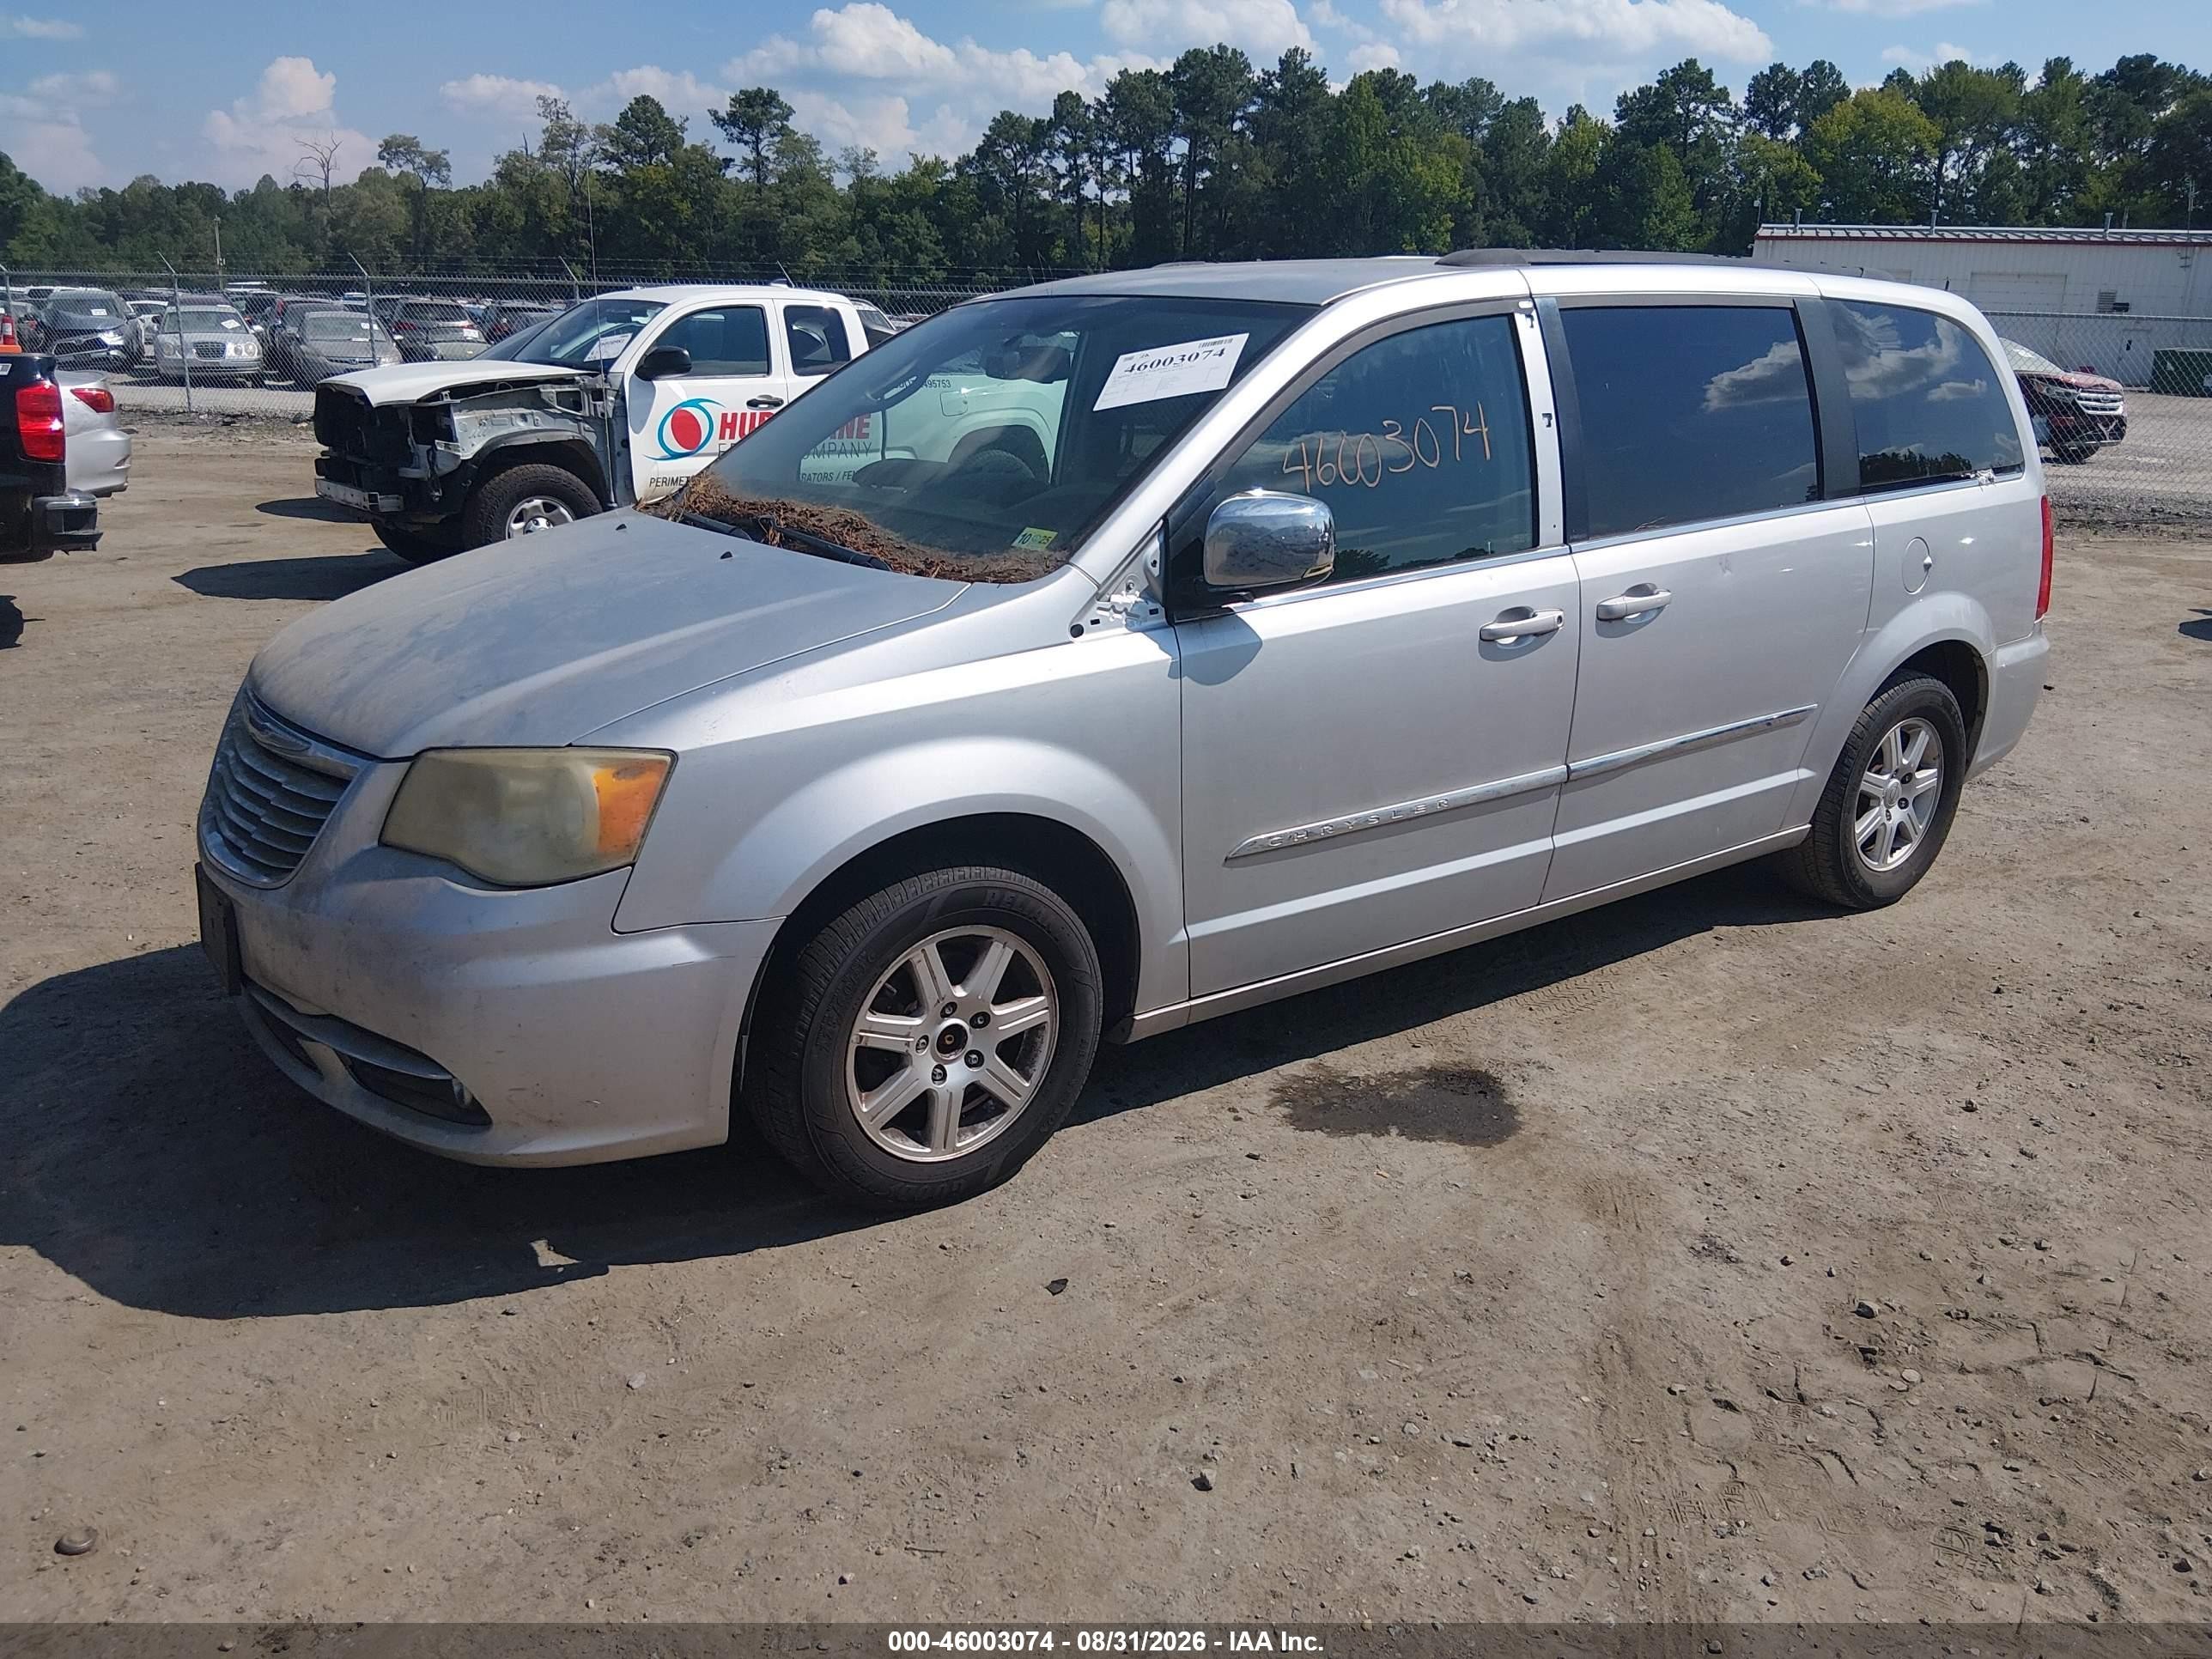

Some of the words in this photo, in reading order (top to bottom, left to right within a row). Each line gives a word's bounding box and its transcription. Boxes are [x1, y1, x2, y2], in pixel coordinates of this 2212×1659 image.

[1124, 348, 1225, 373] 46003074
[925, 379, 951, 389] 95753
[1283, 401, 1491, 494] 46003074
[1267, 799, 1450, 847] CHRYSLER
